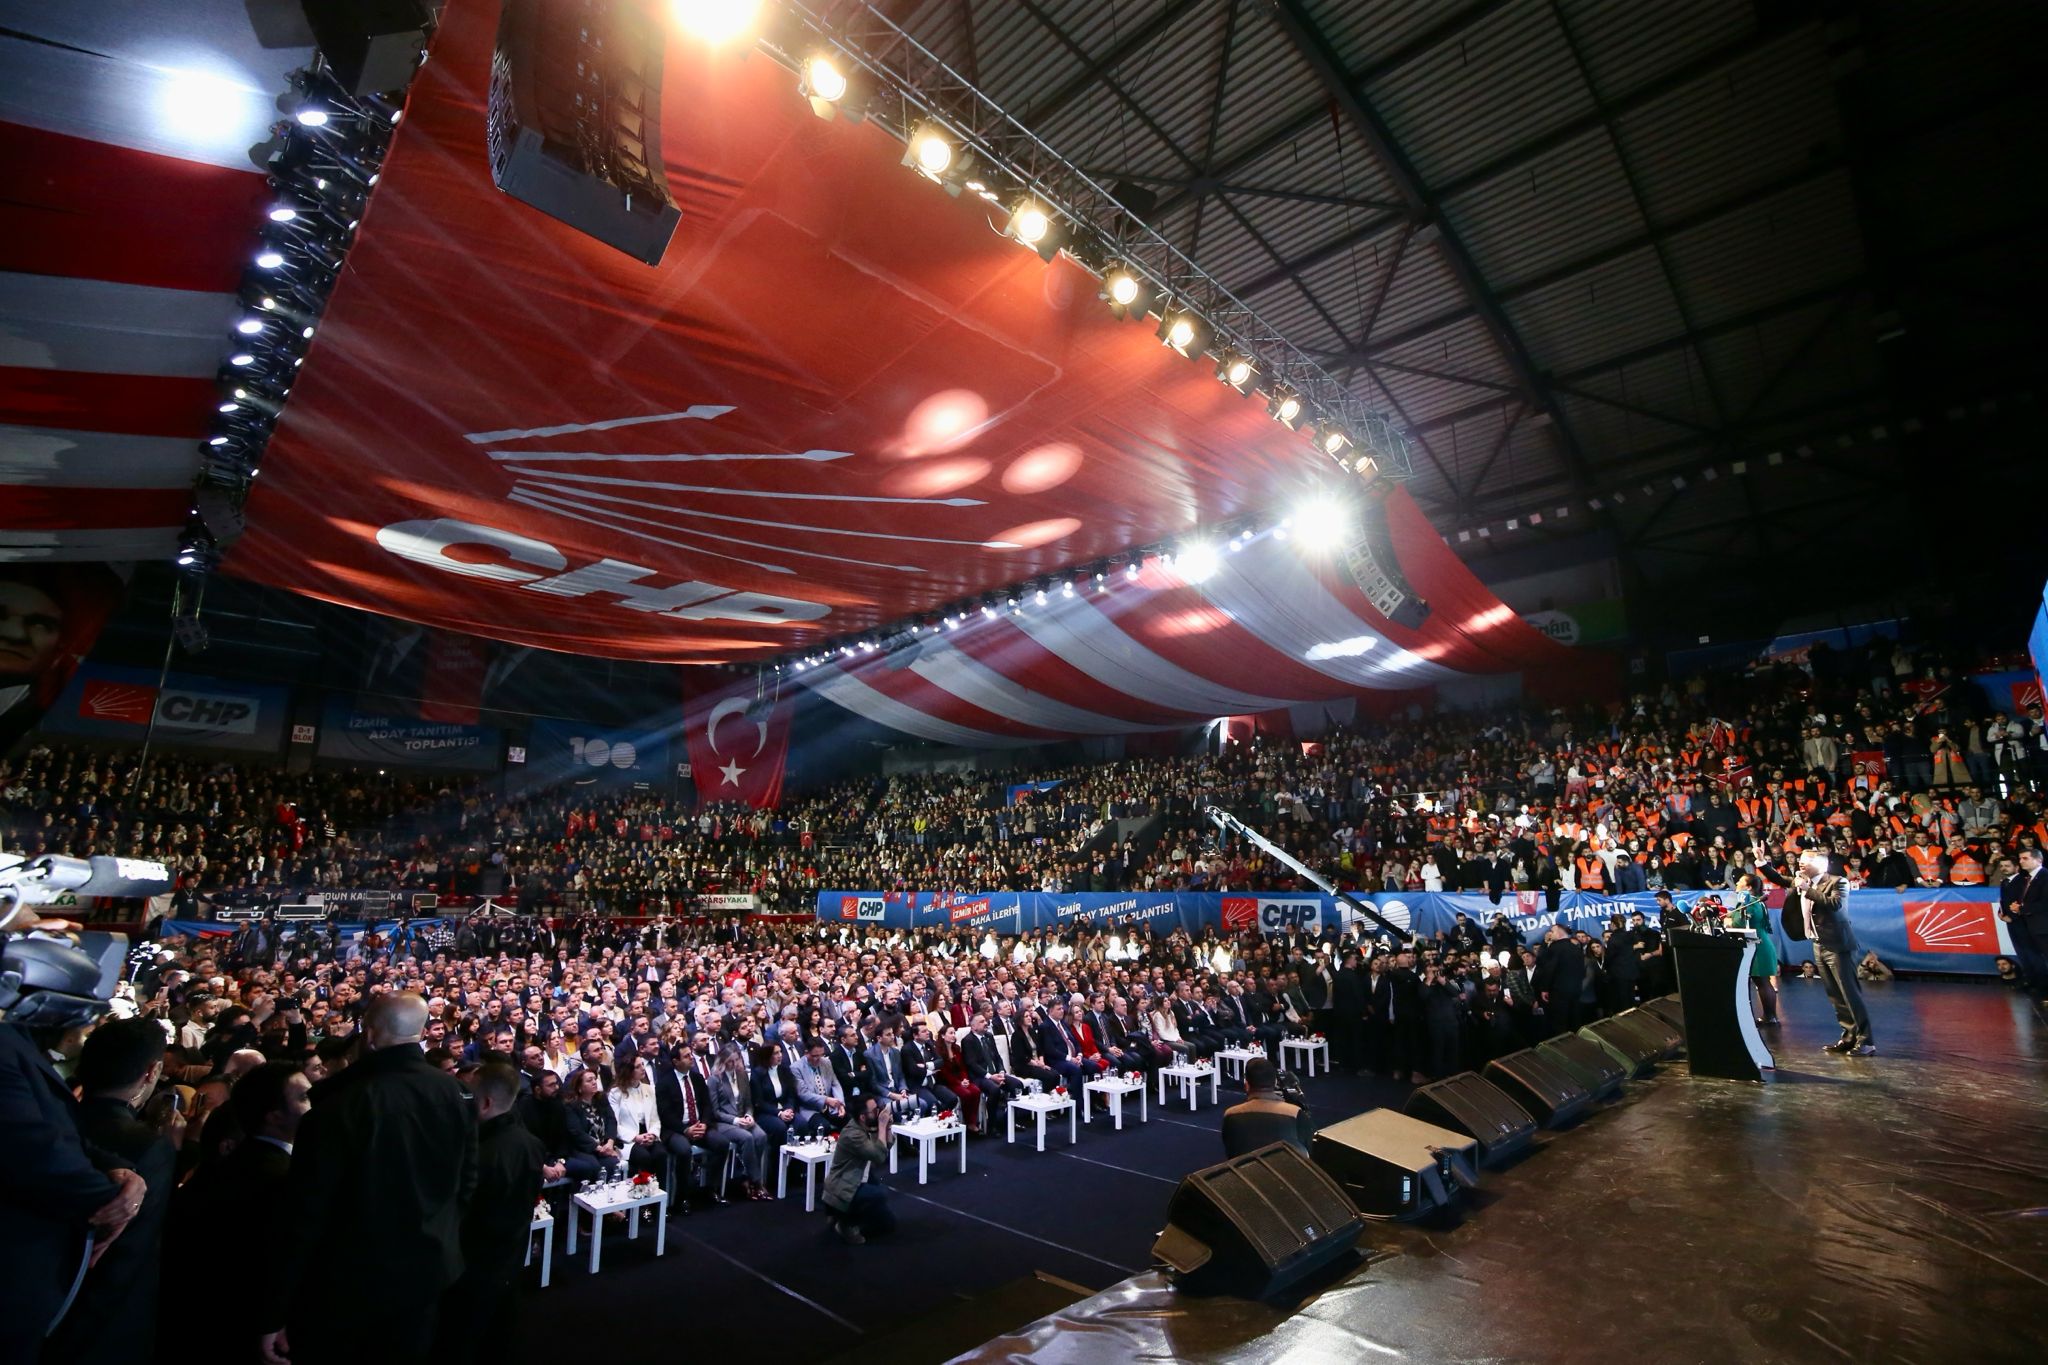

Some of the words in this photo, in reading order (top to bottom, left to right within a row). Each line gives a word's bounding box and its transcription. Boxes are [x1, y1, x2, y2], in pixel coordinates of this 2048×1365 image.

[376, 518, 832, 624] CHP
[161, 696, 250, 725] CHP
[349, 714, 389, 729] İZMİR
[369, 728, 407, 740] ADAY
[411, 725, 464, 739] TANITIM
[405, 737, 480, 751] TOPLANTISI
[569, 736, 637, 769] 100
[860, 901, 883, 916] CHP
[953, 906, 972, 920] İZMİR
[972, 902, 987, 915] İÇİN
[1057, 902, 1082, 918] İZMİR
[1099, 899, 1137, 917] TANITIM
[1262, 904, 1316, 929] CHP
[1517, 912, 1559, 932] ADAY
[1563, 902, 1637, 922] TANITIM
[971, 915, 991, 927] DAHA
